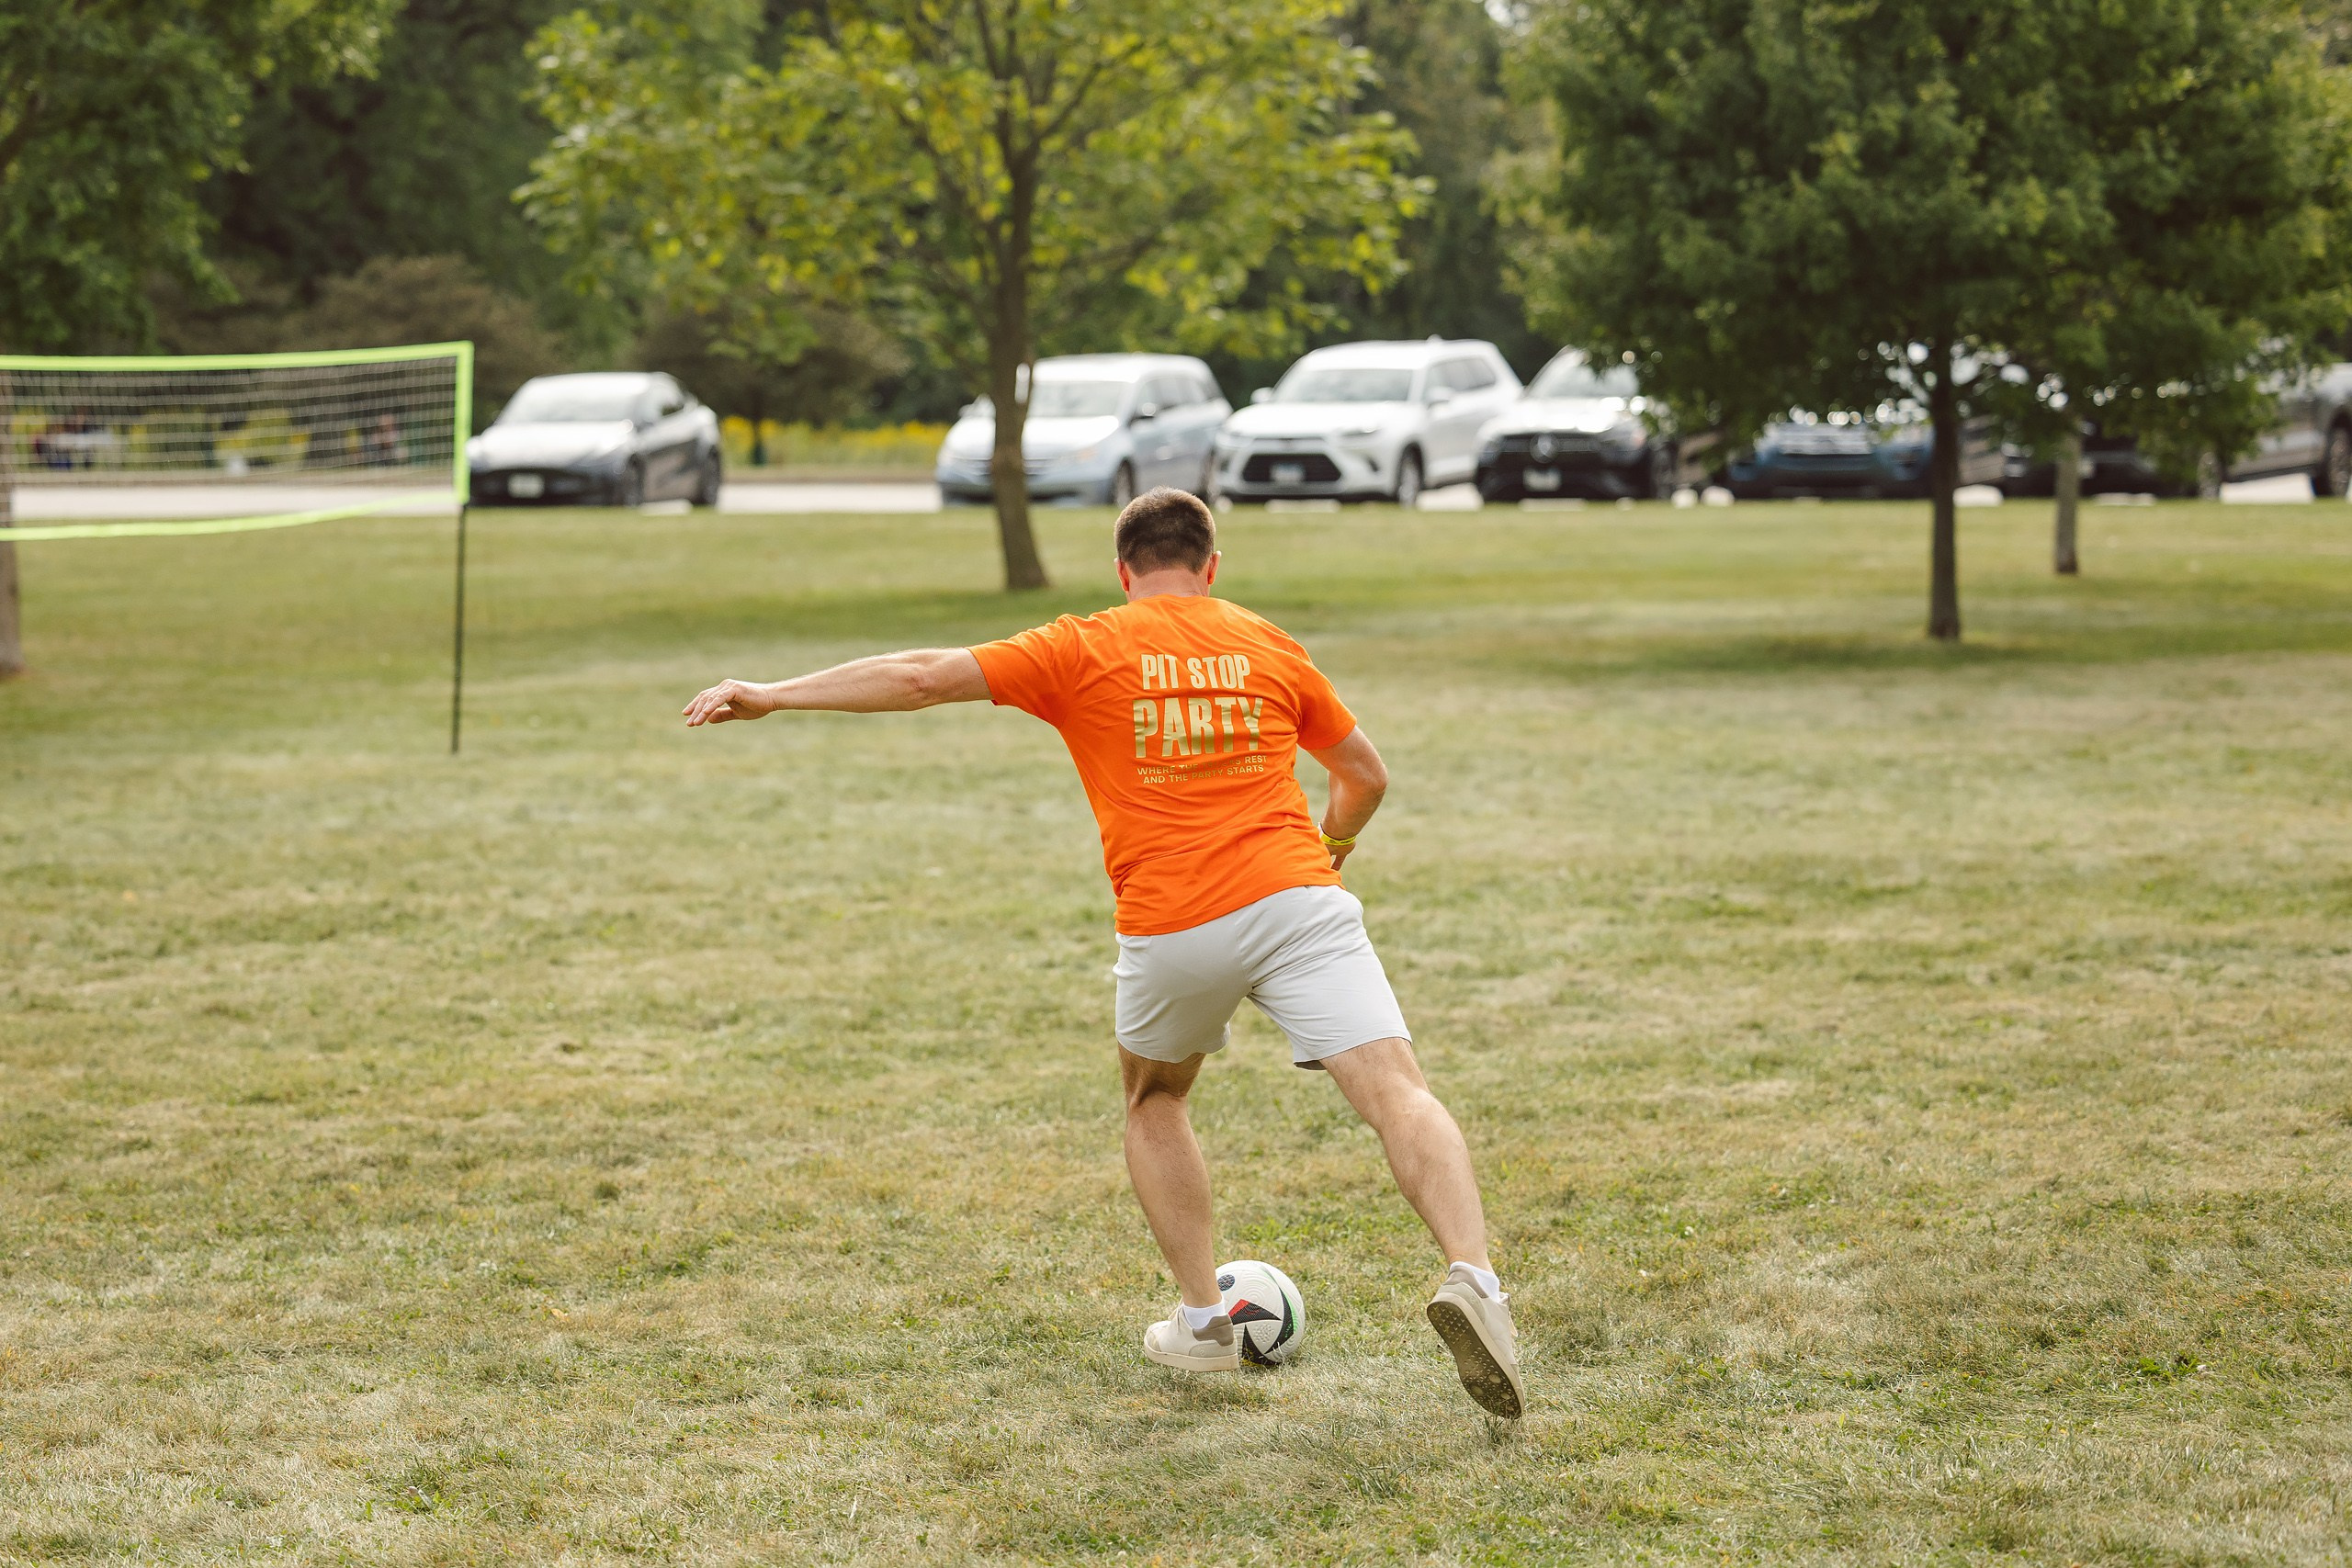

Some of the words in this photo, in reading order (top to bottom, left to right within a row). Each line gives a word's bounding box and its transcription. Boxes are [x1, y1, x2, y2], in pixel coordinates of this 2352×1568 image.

[1140, 654, 1180, 689] PIT
[1187, 654, 1250, 689] STOP
[1133, 697, 1263, 758] PARTY
[1137, 765, 1176, 775] WHERE
[1245, 754, 1267, 763] REST
[1143, 775, 1166, 784] AND
[1169, 773, 1188, 783] THE
[1192, 769, 1223, 779] PARTY
[1227, 764, 1264, 775] STARTS
